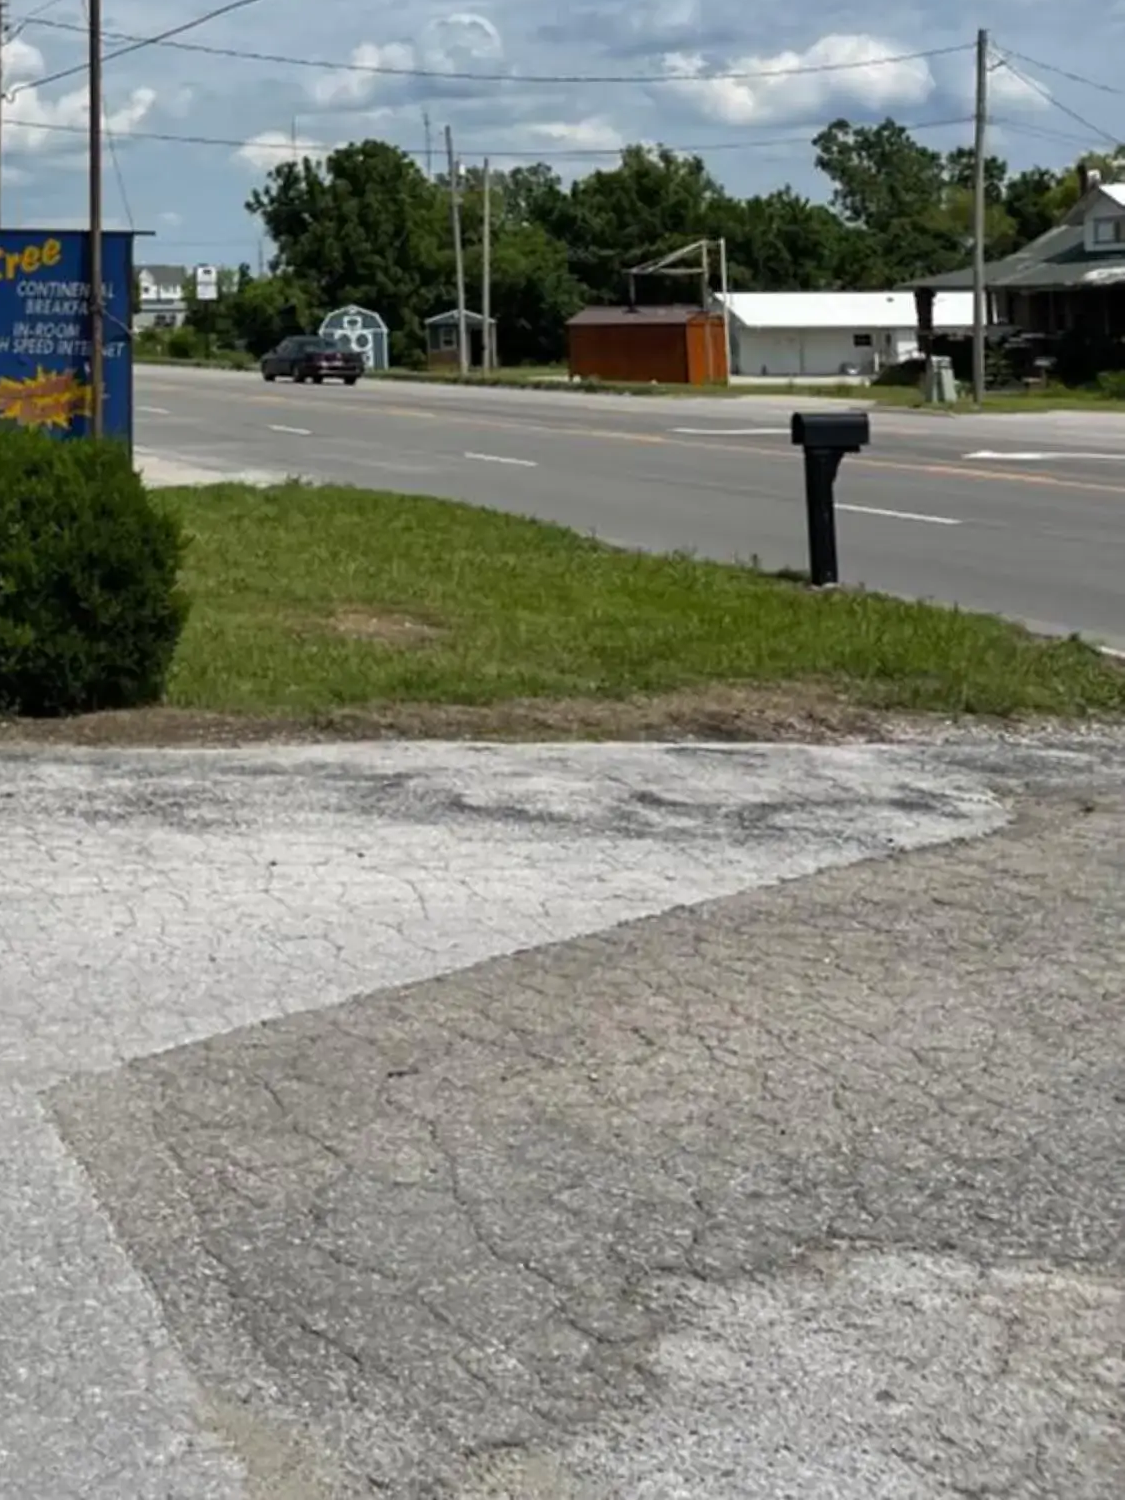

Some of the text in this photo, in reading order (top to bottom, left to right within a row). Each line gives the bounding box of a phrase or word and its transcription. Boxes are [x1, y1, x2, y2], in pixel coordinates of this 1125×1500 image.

[16, 280, 114, 299] CONTINENAL
[25, 298, 97, 315] BREAKFA
[13, 322, 81, 338] IN-ROOM
[13, 338, 55, 355] SPEED
